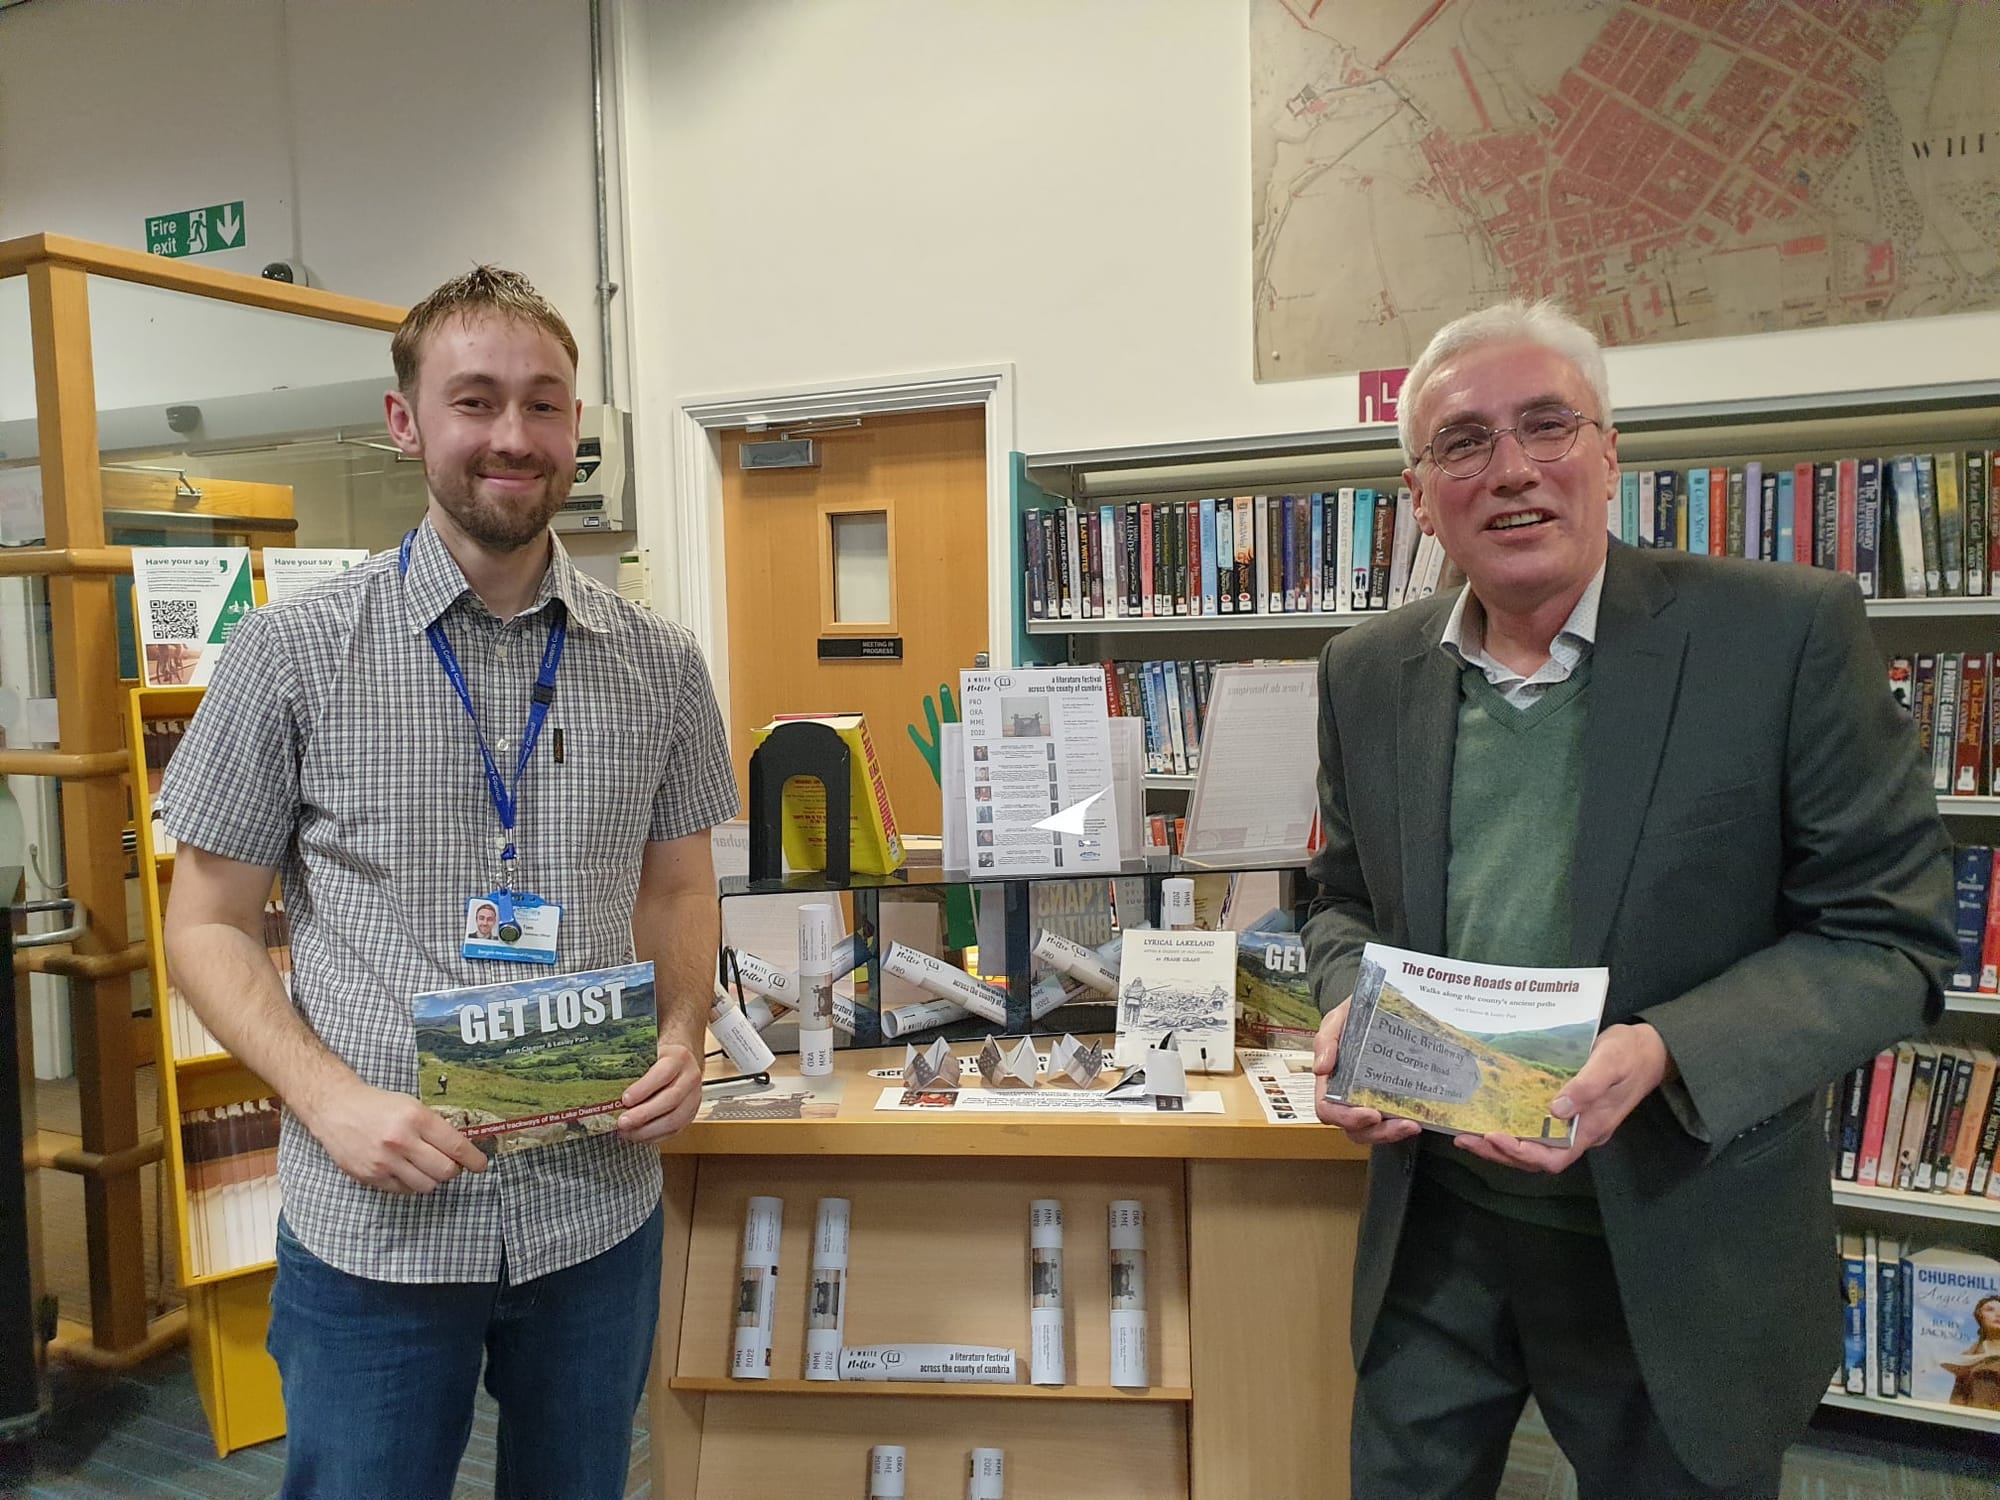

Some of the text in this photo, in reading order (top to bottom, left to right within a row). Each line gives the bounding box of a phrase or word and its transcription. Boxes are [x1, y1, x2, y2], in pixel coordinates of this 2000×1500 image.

[151, 220, 176, 236] Fire
[153, 238, 177, 254] exit
[1862, 480, 1876, 551] The Runaway
[1376, 509, 1386, 549] Remember
[1826, 522, 1835, 555] FLYNN
[145, 558, 209, 567] Have your say
[274, 558, 332, 567] Have your say
[1060, 538, 1068, 584] ADLER-OLSEN
[1056, 685, 1074, 693] county
[1939, 670, 1956, 733] PRIVATE GAMES
[1966, 679, 1982, 746] The Little Angel
[859, 720, 897, 842] PLAIN HEROINES
[750, 963, 767, 974] WRITE
[891, 965, 906, 975] PRO
[1265, 943, 1306, 972] GET
[1402, 962, 1580, 993] The Corpse Roads of Cumbria
[952, 979, 1003, 1007] across the county of
[1419, 985, 1440, 996] Walks
[1442, 991, 1462, 1001] along
[1509, 1000, 1535, 1008] ancient
[1536, 1000, 1556, 1009] paths
[460, 981, 627, 1046] GET LOST
[505, 1046, 521, 1055] Alan
[574, 1036, 589, 1044] Park
[1378, 1018, 1465, 1066] Public Bridleway
[1372, 1043, 1450, 1076] Old Corpse Road
[1364, 1067, 1414, 1089] Swindale
[1416, 1080, 1438, 1095] Head
[468, 1128, 479, 1136] the
[480, 1124, 506, 1134] ancient
[507, 1119, 540, 1130] trackways
[541, 1115, 548, 1123] of
[549, 1113, 561, 1122] the
[561, 1110, 578, 1120] Lake
[578, 1106, 601, 1116] District
[602, 1102, 614, 1111] and
[1920, 1328, 1971, 1340] JACKSON
[746, 1349, 755, 1368] 2022
[813, 1351, 821, 1370] MME
[825, 1351, 833, 1370] 2022
[920, 1364, 1010, 1375] across the county of cumbria
[955, 1352, 985, 1362] literature
[986, 1353, 1010, 1362] festival
